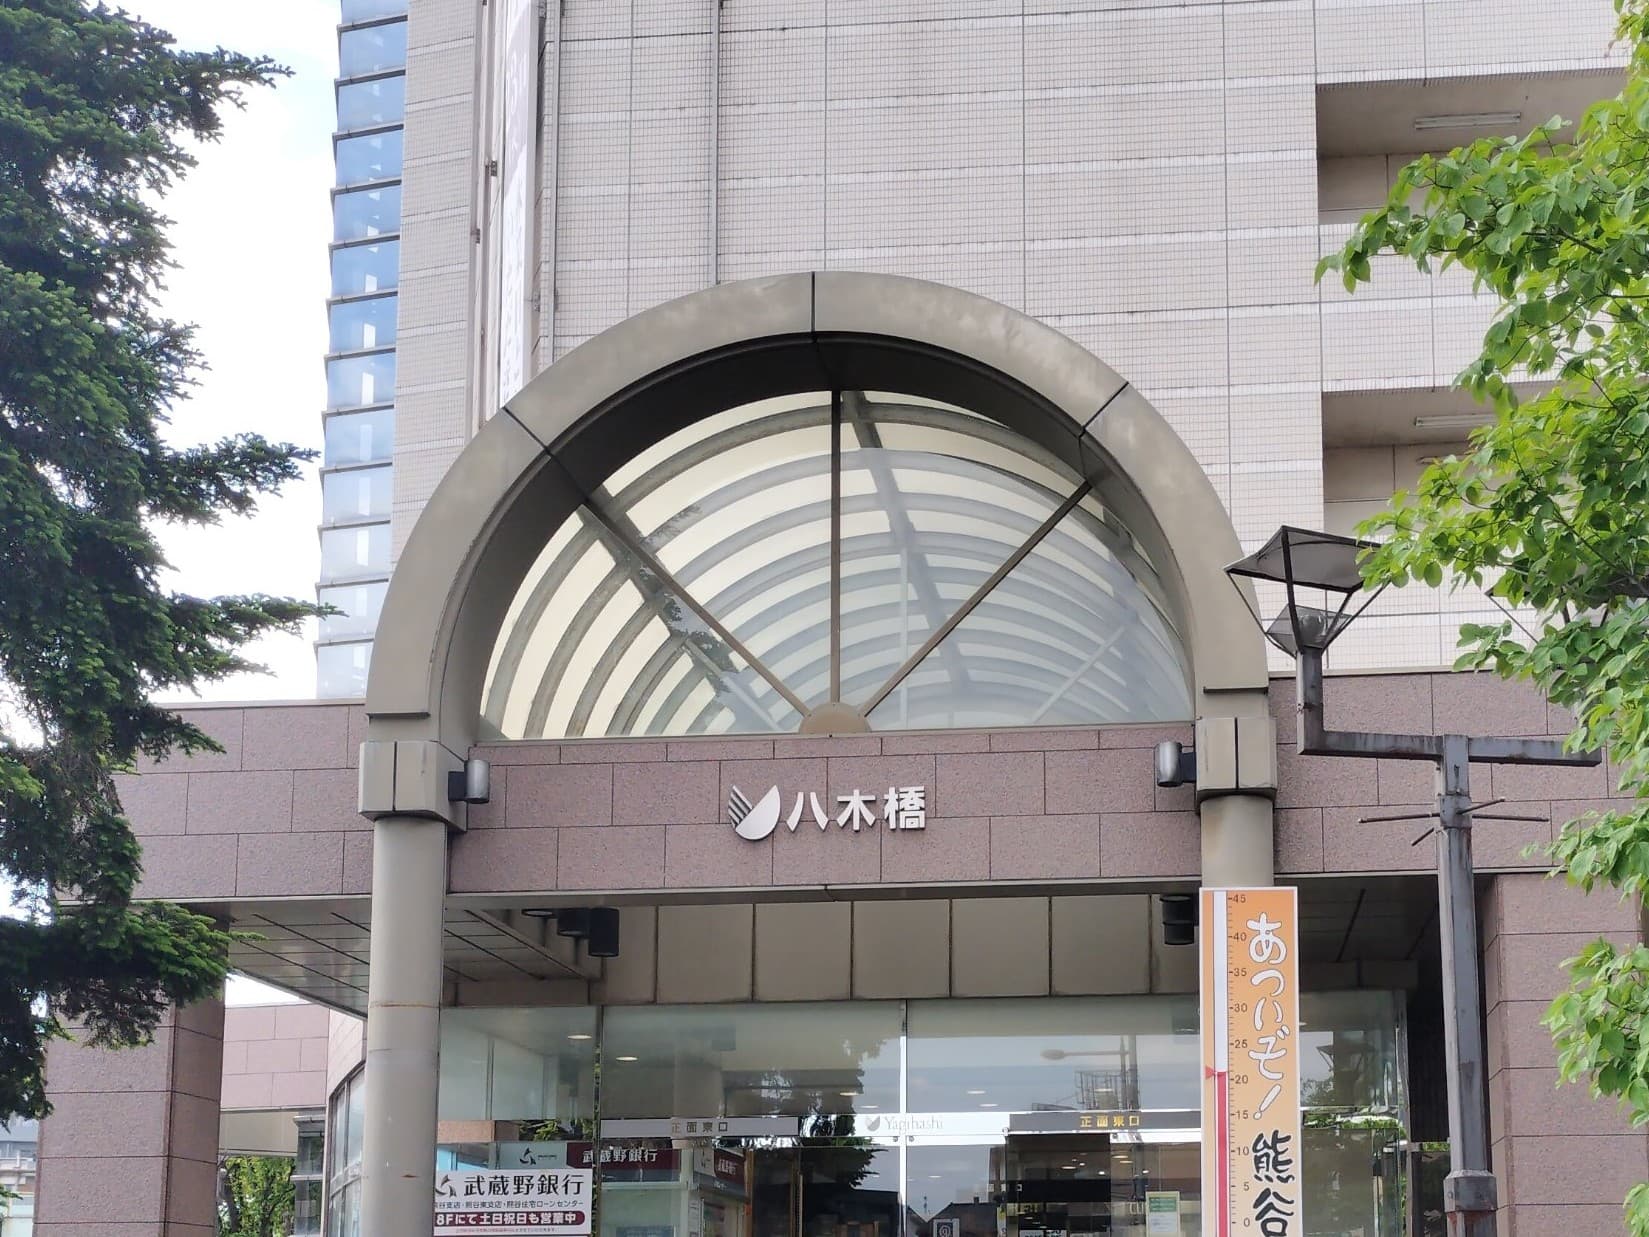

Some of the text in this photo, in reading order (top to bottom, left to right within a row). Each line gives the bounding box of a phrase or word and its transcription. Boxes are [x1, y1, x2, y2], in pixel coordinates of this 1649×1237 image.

[786, 785, 926, 832] 八木橋
[1233, 894, 1246, 903] 45
[1233, 932, 1247, 941] 40
[1233, 968, 1247, 977] 35
[1234, 1003, 1248, 1012] 30
[1234, 1039, 1248, 1049] 25
[1235, 1074, 1249, 1084] 20
[1236, 1110, 1249, 1119] 15
[1080, 1115, 1140, 1128] 正面東口
[672, 1122, 728, 1134] 正面東口
[582, 1149, 658, 1163] 武蔵野銀行
[1237, 1146, 1250, 1156] 10
[464, 1174, 585, 1197] 武蔵野銀行
[1243, 1181, 1250, 1191] 5
[436, 1212, 577, 1226] 8Fにて土日祝日も営業中
[1243, 1217, 1250, 1227] 0
